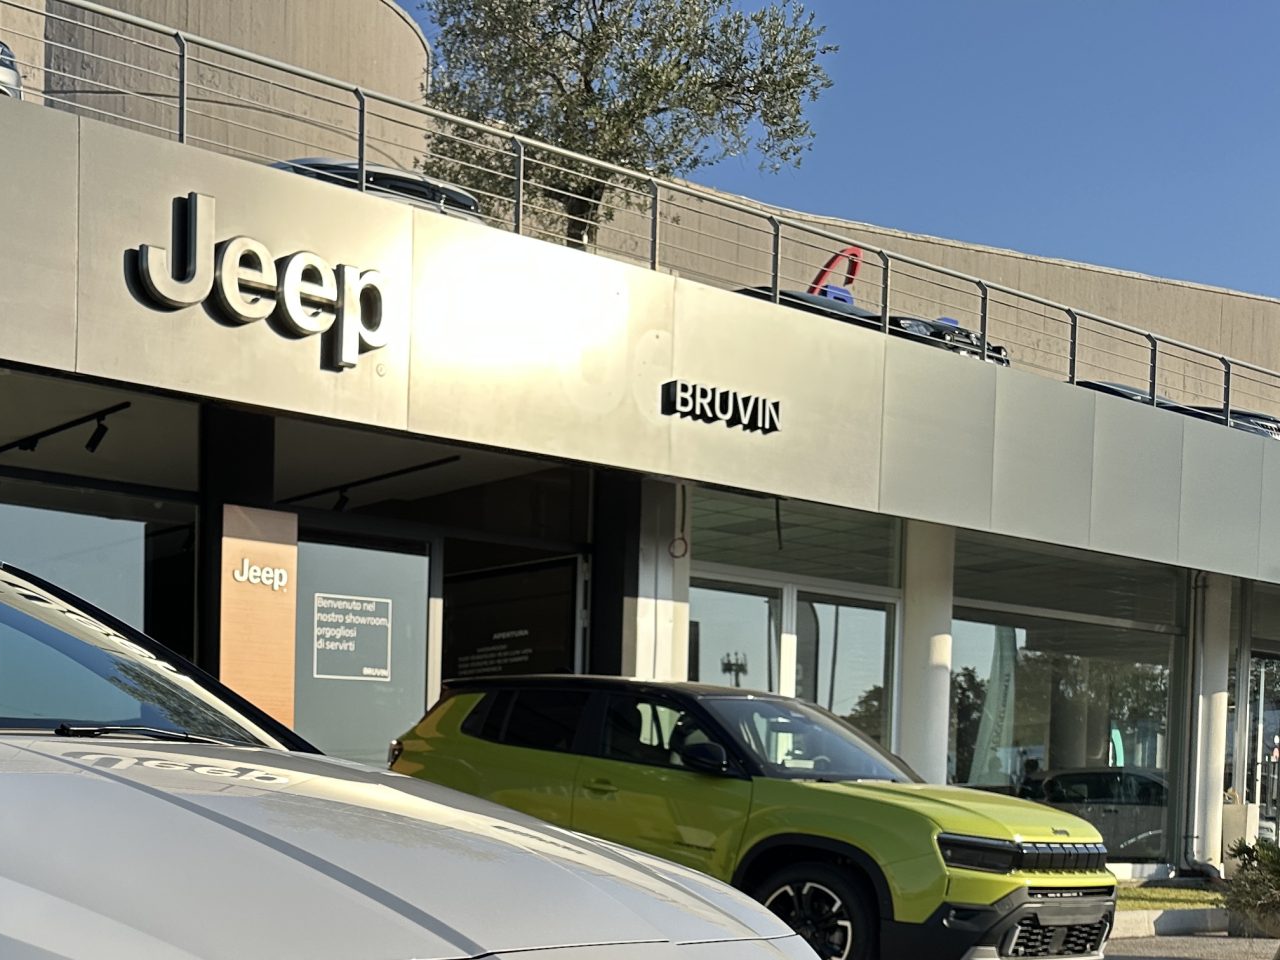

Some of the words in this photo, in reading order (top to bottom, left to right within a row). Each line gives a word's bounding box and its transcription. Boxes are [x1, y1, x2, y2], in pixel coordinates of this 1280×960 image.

[138, 191, 389, 369] Jeep
[674, 379, 782, 432] BRUVIN
[233, 558, 288, 590] Jeep
[317, 597, 361, 611] Benvenuto
[363, 602, 376, 611] nel
[317, 612, 344, 623] nostro
[317, 626, 357, 639] orgogliosi
[317, 639, 325, 649] di
[326, 640, 355, 651] servirti
